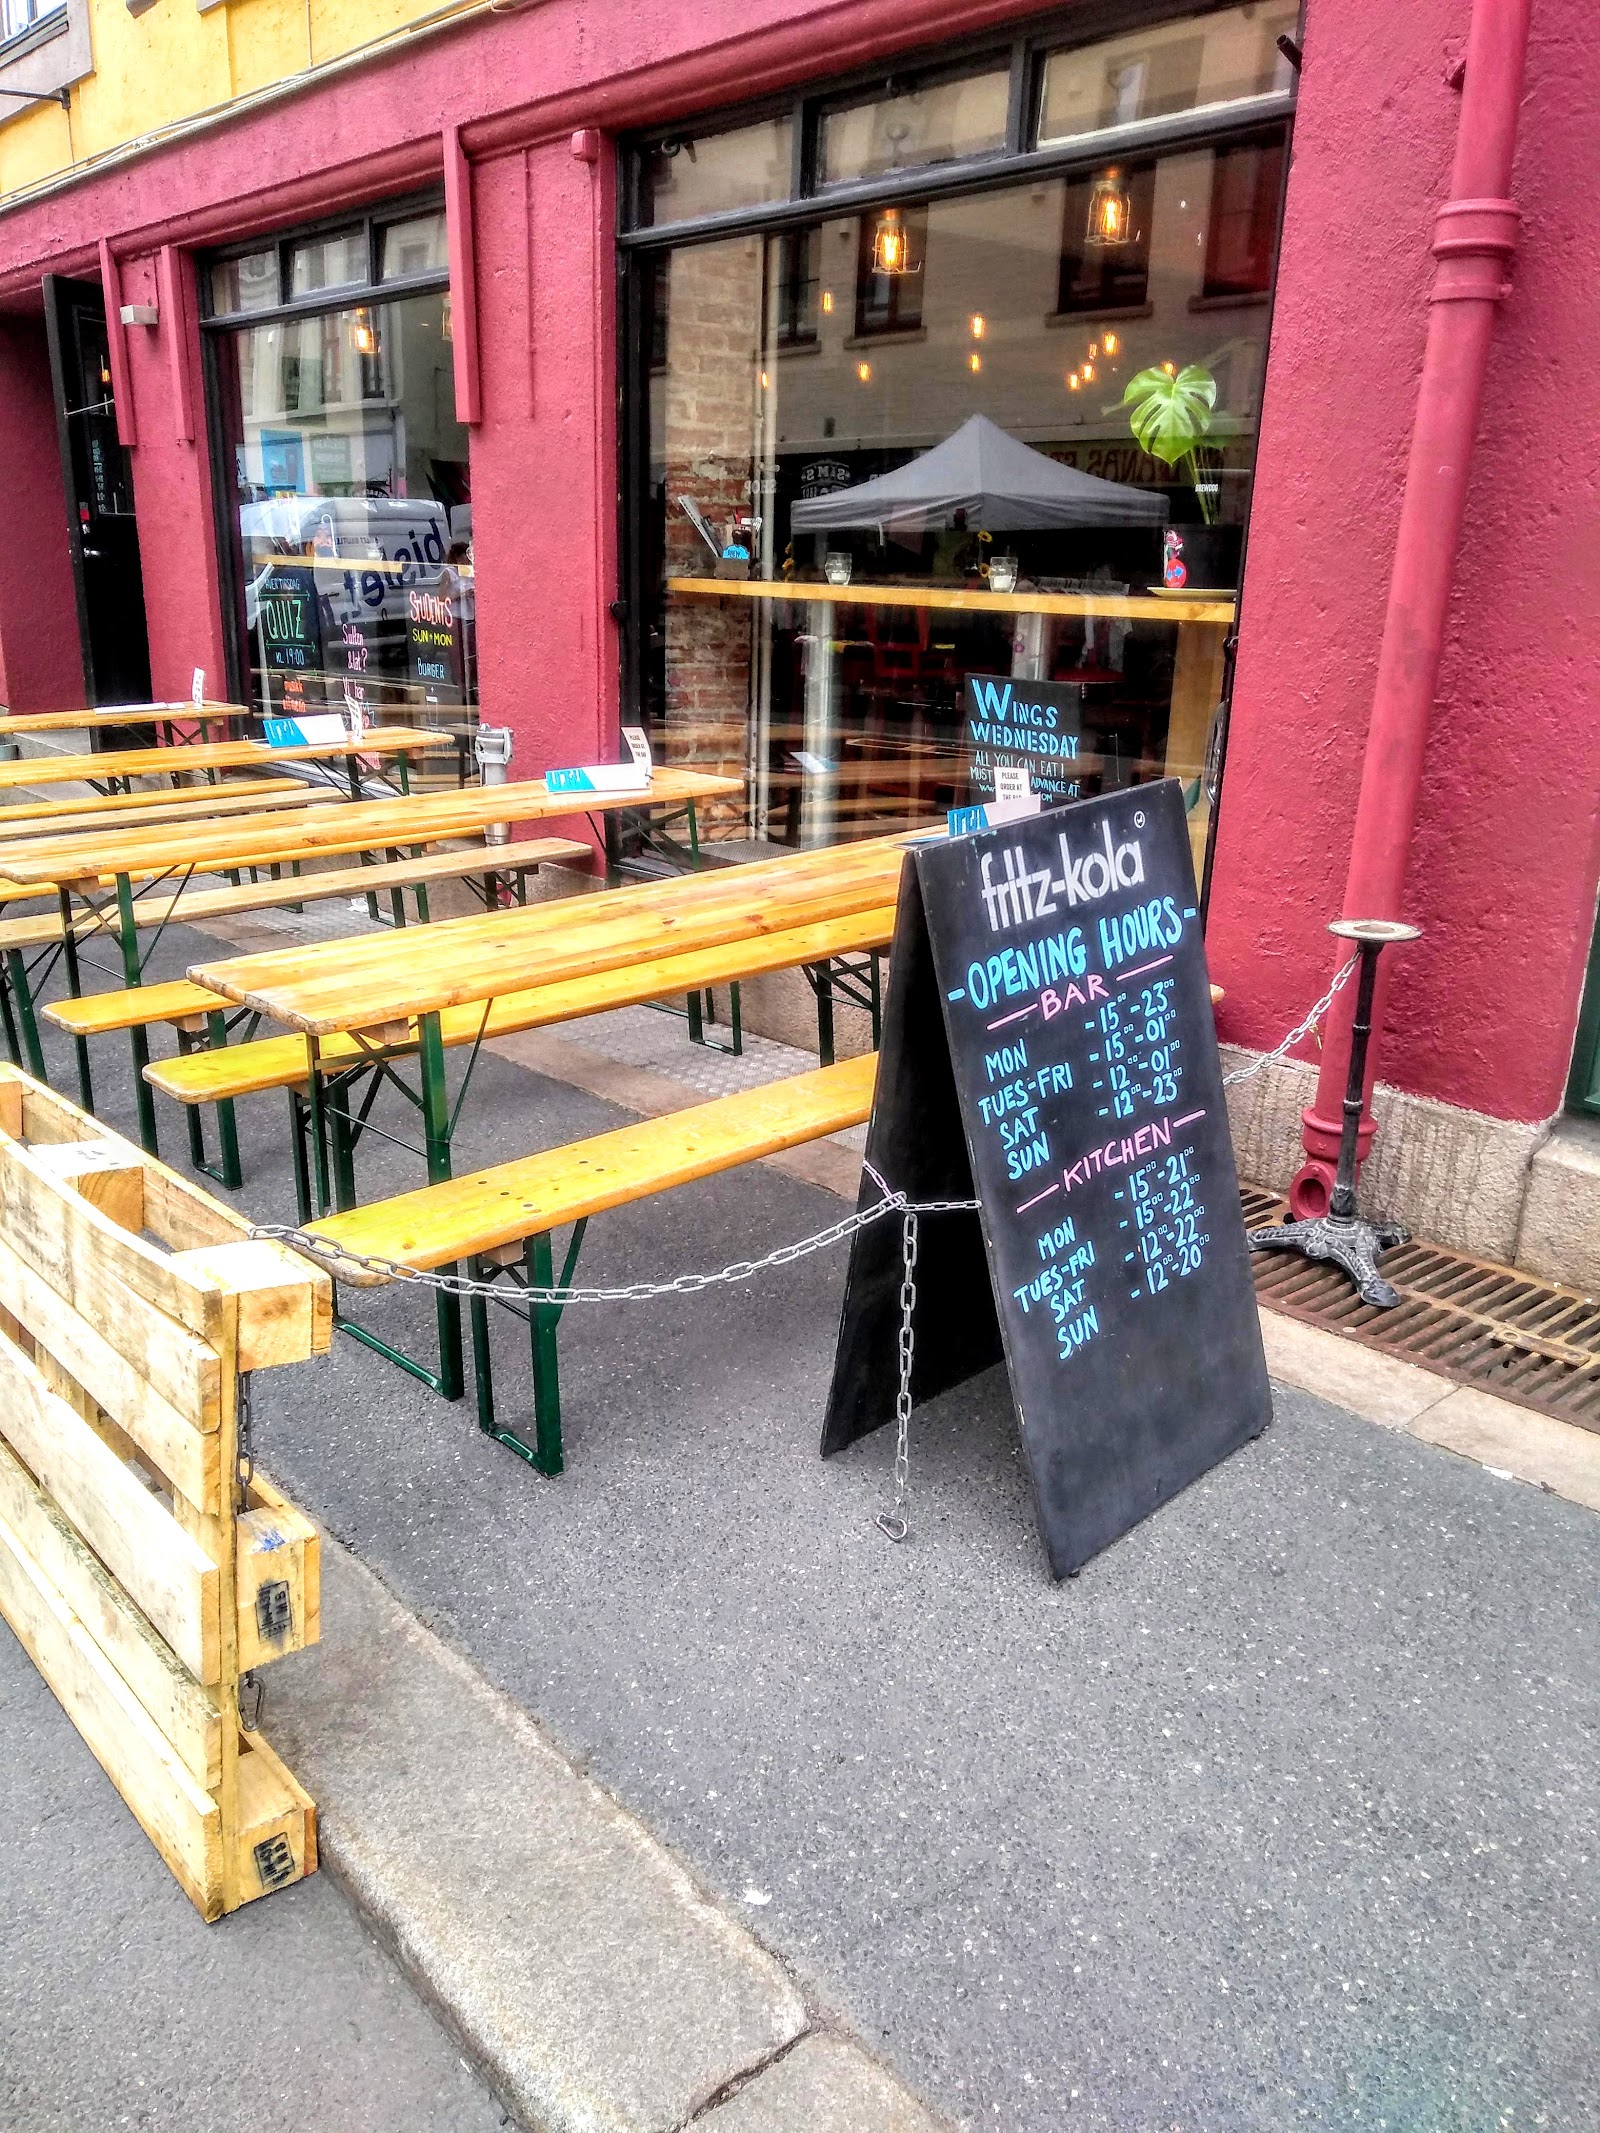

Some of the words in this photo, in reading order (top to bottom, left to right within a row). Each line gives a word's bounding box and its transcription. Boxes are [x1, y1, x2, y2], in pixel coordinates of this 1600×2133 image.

[266, 600, 305, 639] QUIZ
[409, 590, 453, 628] STUDENTS
[417, 657, 445, 679] BURGER
[971, 678, 1059, 729] WINGS
[970, 719, 1079, 760] WEDNESDAY
[970, 766, 994, 782] MUST
[1031, 775, 1066, 793] ADVANCE
[1067, 783, 1080, 798] AT
[975, 750, 990, 767] ALL
[994, 753, 1013, 769] YOU
[1017, 757, 1036, 774] CAN
[1001, 772, 1019, 780] PLEASE
[1000, 783, 1016, 791] ORDER
[1039, 974, 1110, 1021] BAR
[985, 1038, 1029, 1083] MON
[1000, 1106, 1039, 1150] SAT
[1006, 1131, 1051, 1180] SUN
[1063, 1116, 1172, 1192] KITCHEN
[1037, 1216, 1077, 1260] MON
[1050, 1278, 1086, 1324] SAT
[1057, 1305, 1100, 1360] SUN
